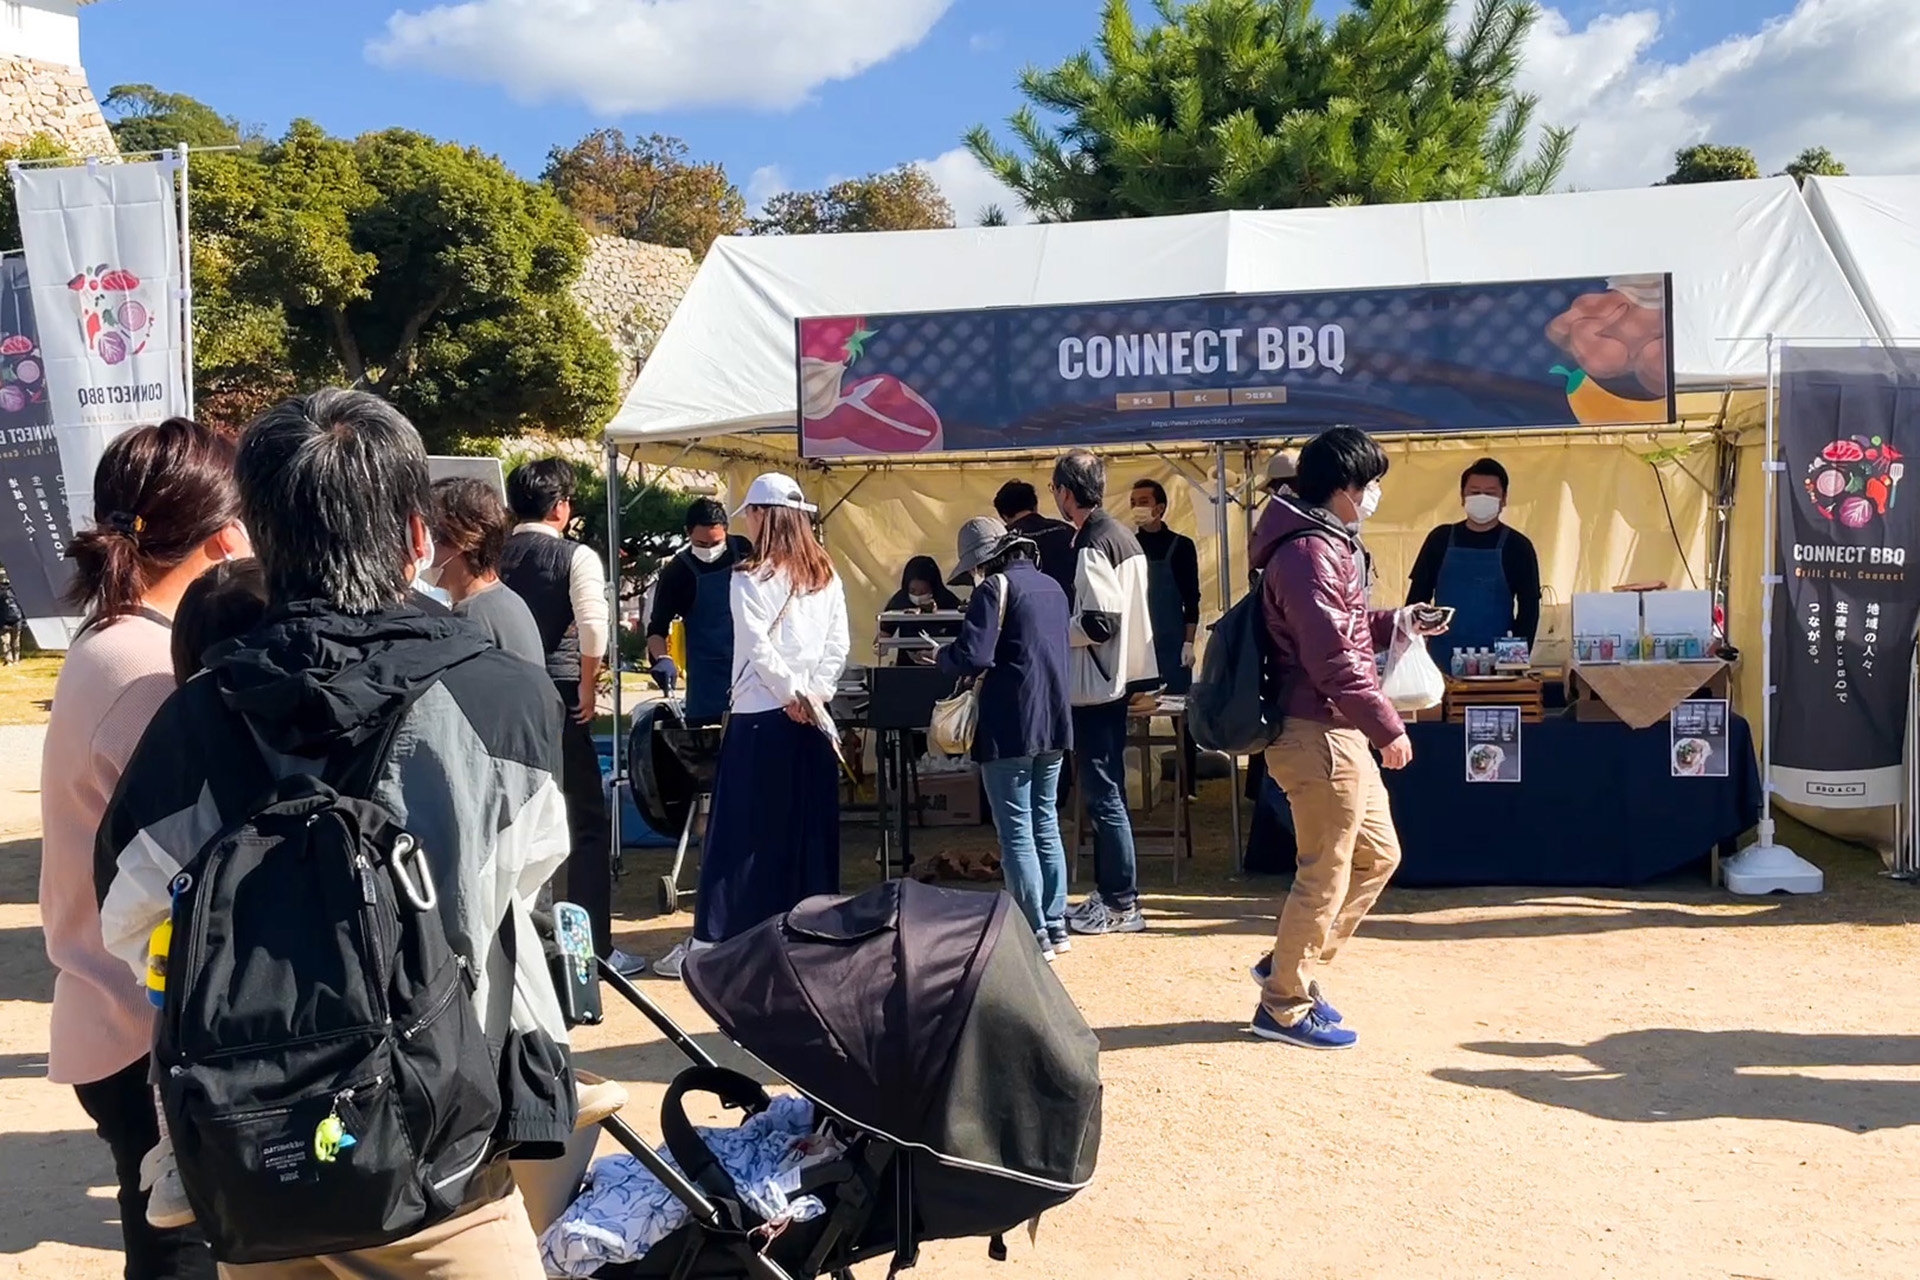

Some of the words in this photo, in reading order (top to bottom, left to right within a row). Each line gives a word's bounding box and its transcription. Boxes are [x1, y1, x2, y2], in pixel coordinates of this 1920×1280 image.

[1058, 328, 1243, 380] CONNECT
[1257, 323, 1346, 375] BBQ
[1793, 543, 1866, 563] CONNECT
[1870, 547, 1906, 567] BBQ
[1795, 567, 1824, 578] Grill.
[1857, 570, 1904, 581] Connect
[1807, 602, 1821, 664] つながる。
[1862, 602, 1880, 677] 地域の人々、
